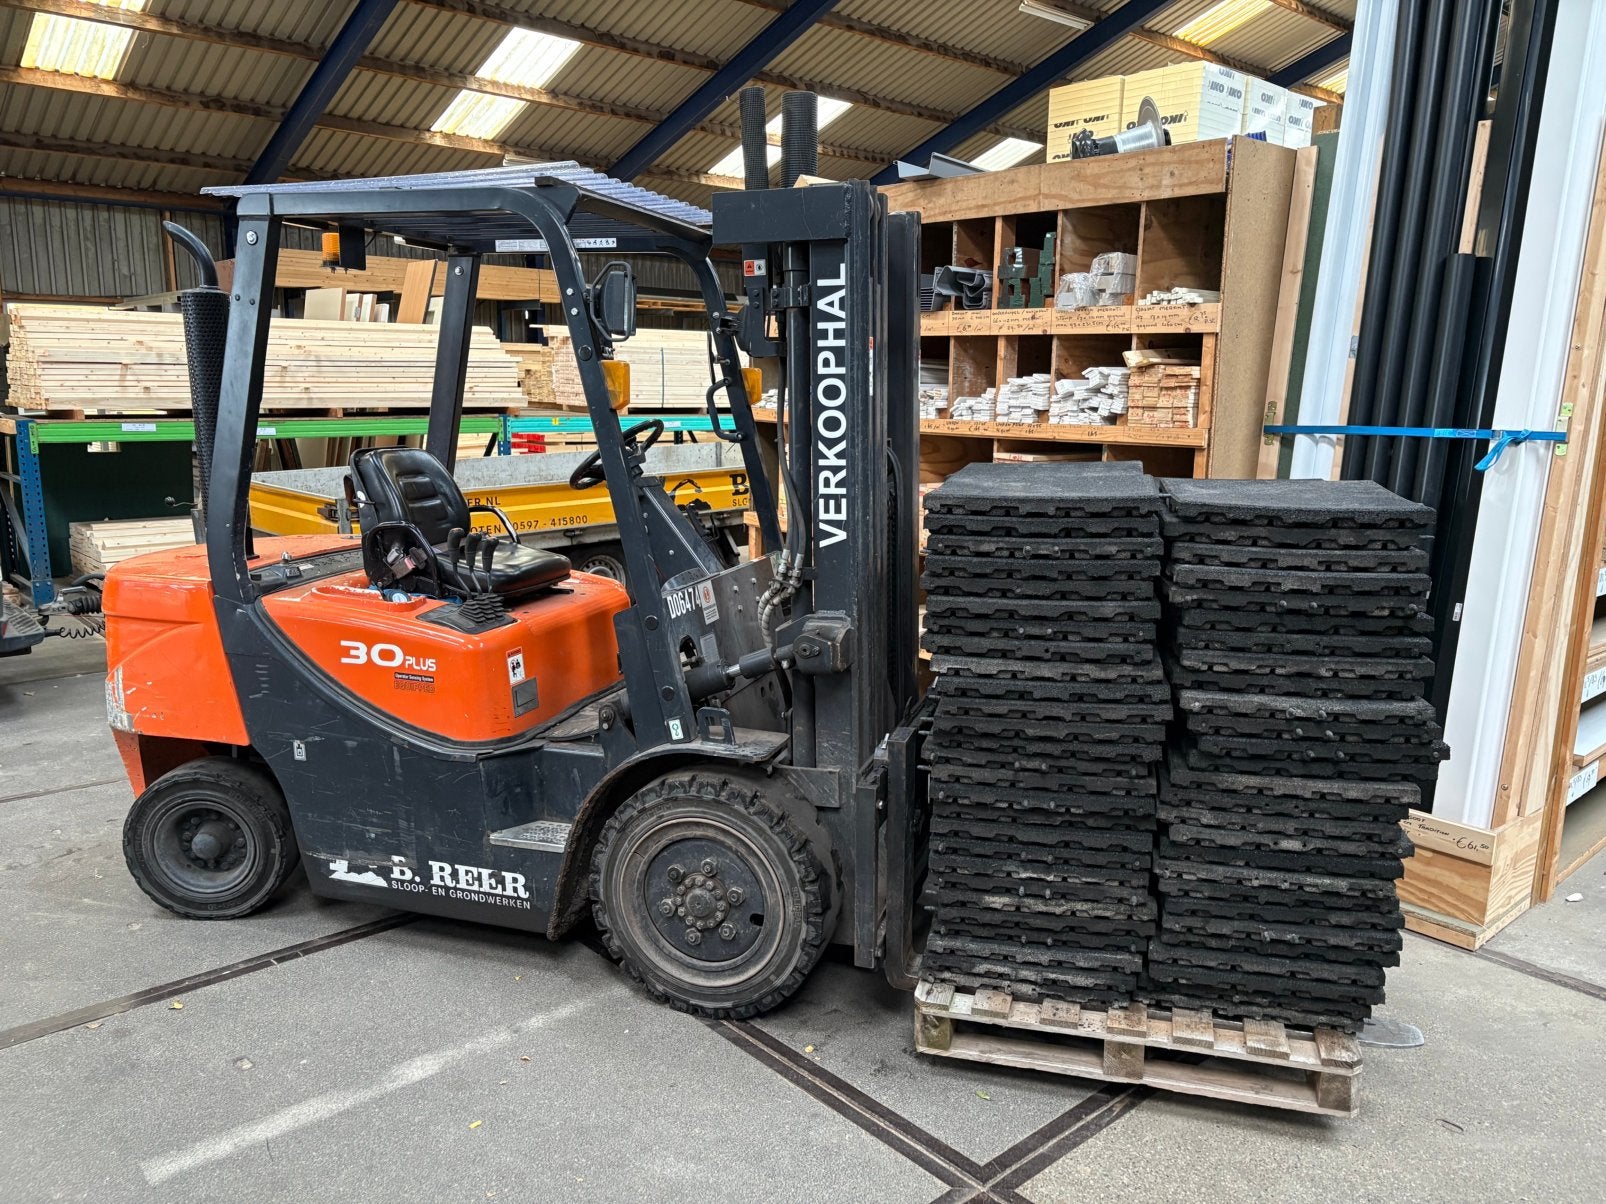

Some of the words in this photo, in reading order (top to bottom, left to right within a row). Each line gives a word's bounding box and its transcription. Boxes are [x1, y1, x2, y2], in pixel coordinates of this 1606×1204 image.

[1209, 80, 1225, 94] IKO
[1229, 86, 1243, 100] IKO
[1300, 98, 1314, 110] IKO
[816, 262, 848, 548] VERKOOPHAL
[729, 473, 750, 496] B
[513, 519, 540, 532] 0597
[550, 514, 588, 527] 415800
[339, 639, 405, 668] 30
[405, 654, 437, 672] PLUS
[390, 854, 421, 883] B.
[428, 860, 530, 899] REER
[391, 880, 429, 893] SLOOP-
[432, 886, 446, 897] EN
[449, 888, 531, 910] GRONDWERKEN
